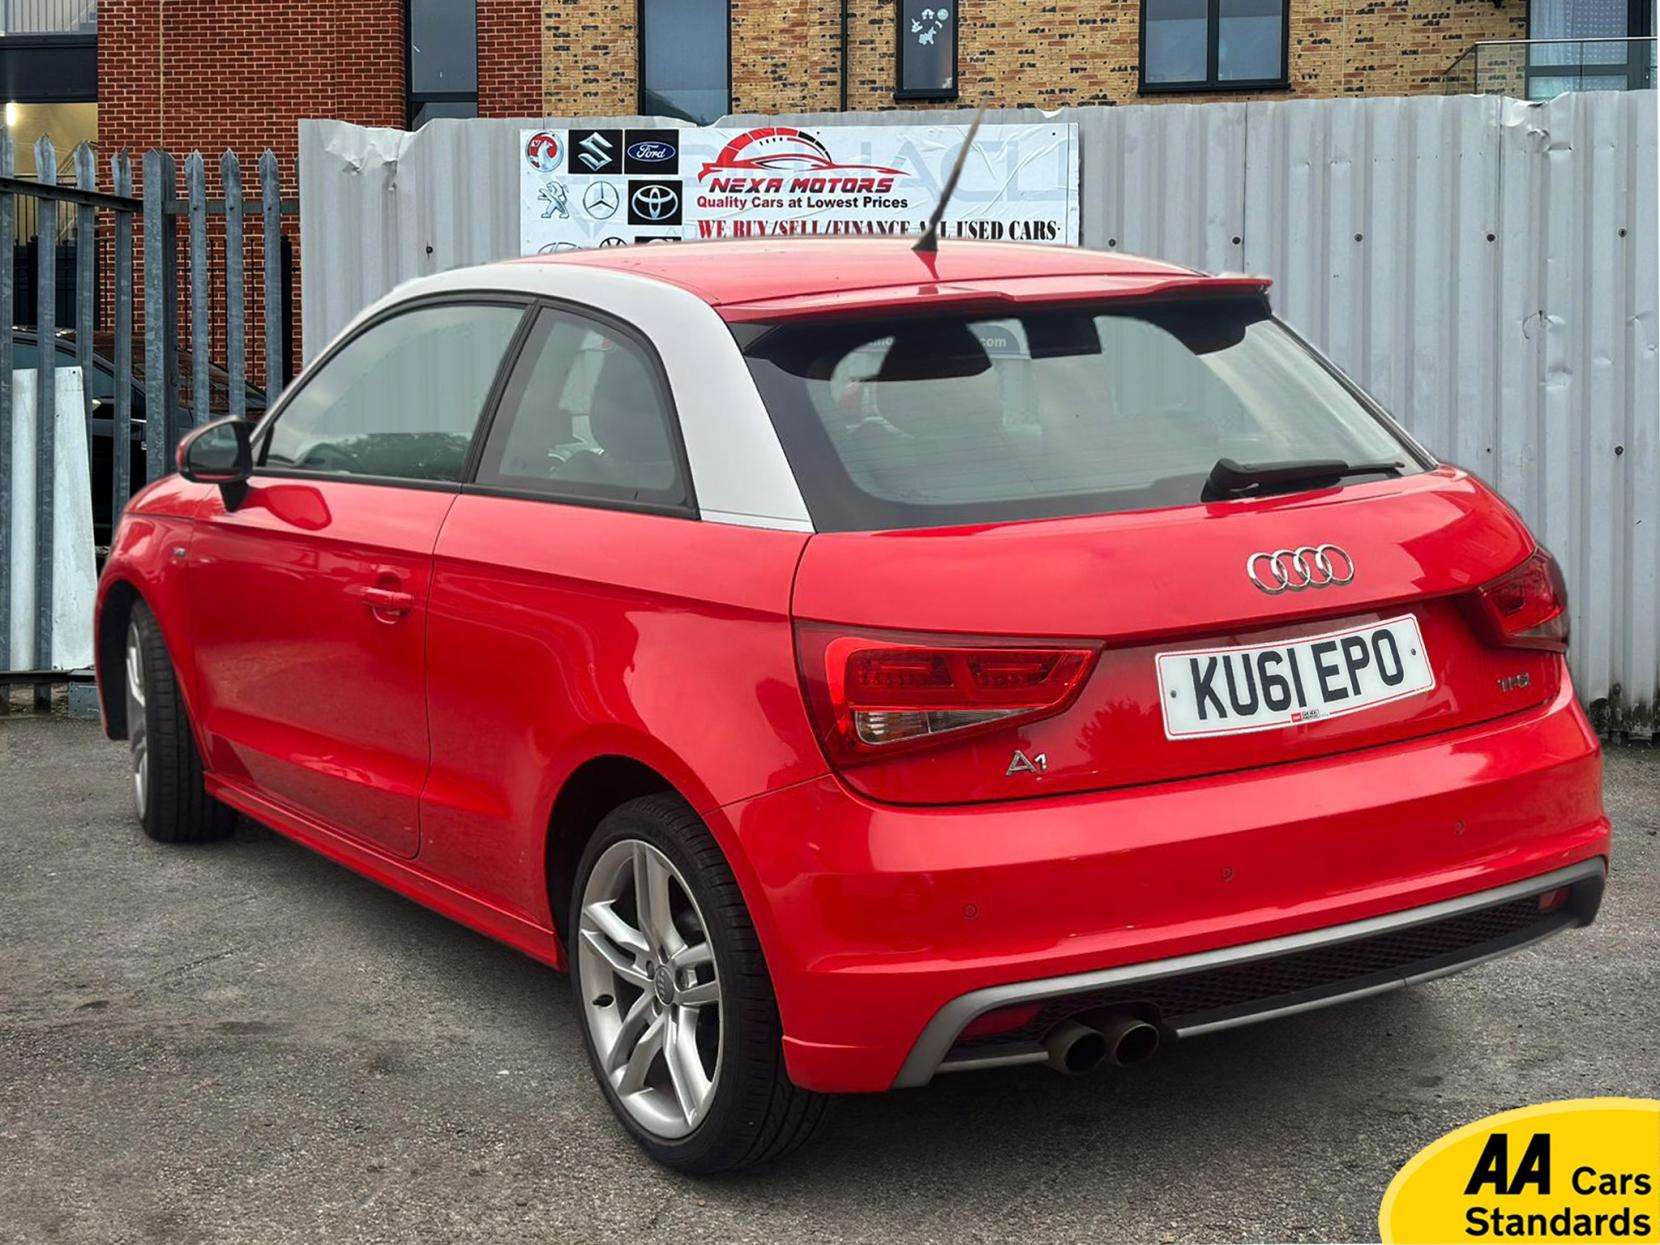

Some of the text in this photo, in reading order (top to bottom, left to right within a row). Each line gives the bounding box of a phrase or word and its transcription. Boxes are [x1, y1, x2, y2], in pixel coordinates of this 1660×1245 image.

[636, 145, 666, 159] Ford
[709, 177, 894, 194] NEXA MOTORS
[697, 195, 908, 210] Quality Cars at Lowest Prices
[697, 220, 727, 239] WE
[957, 220, 1004, 239] USED
[1005, 749, 1047, 776] A1
